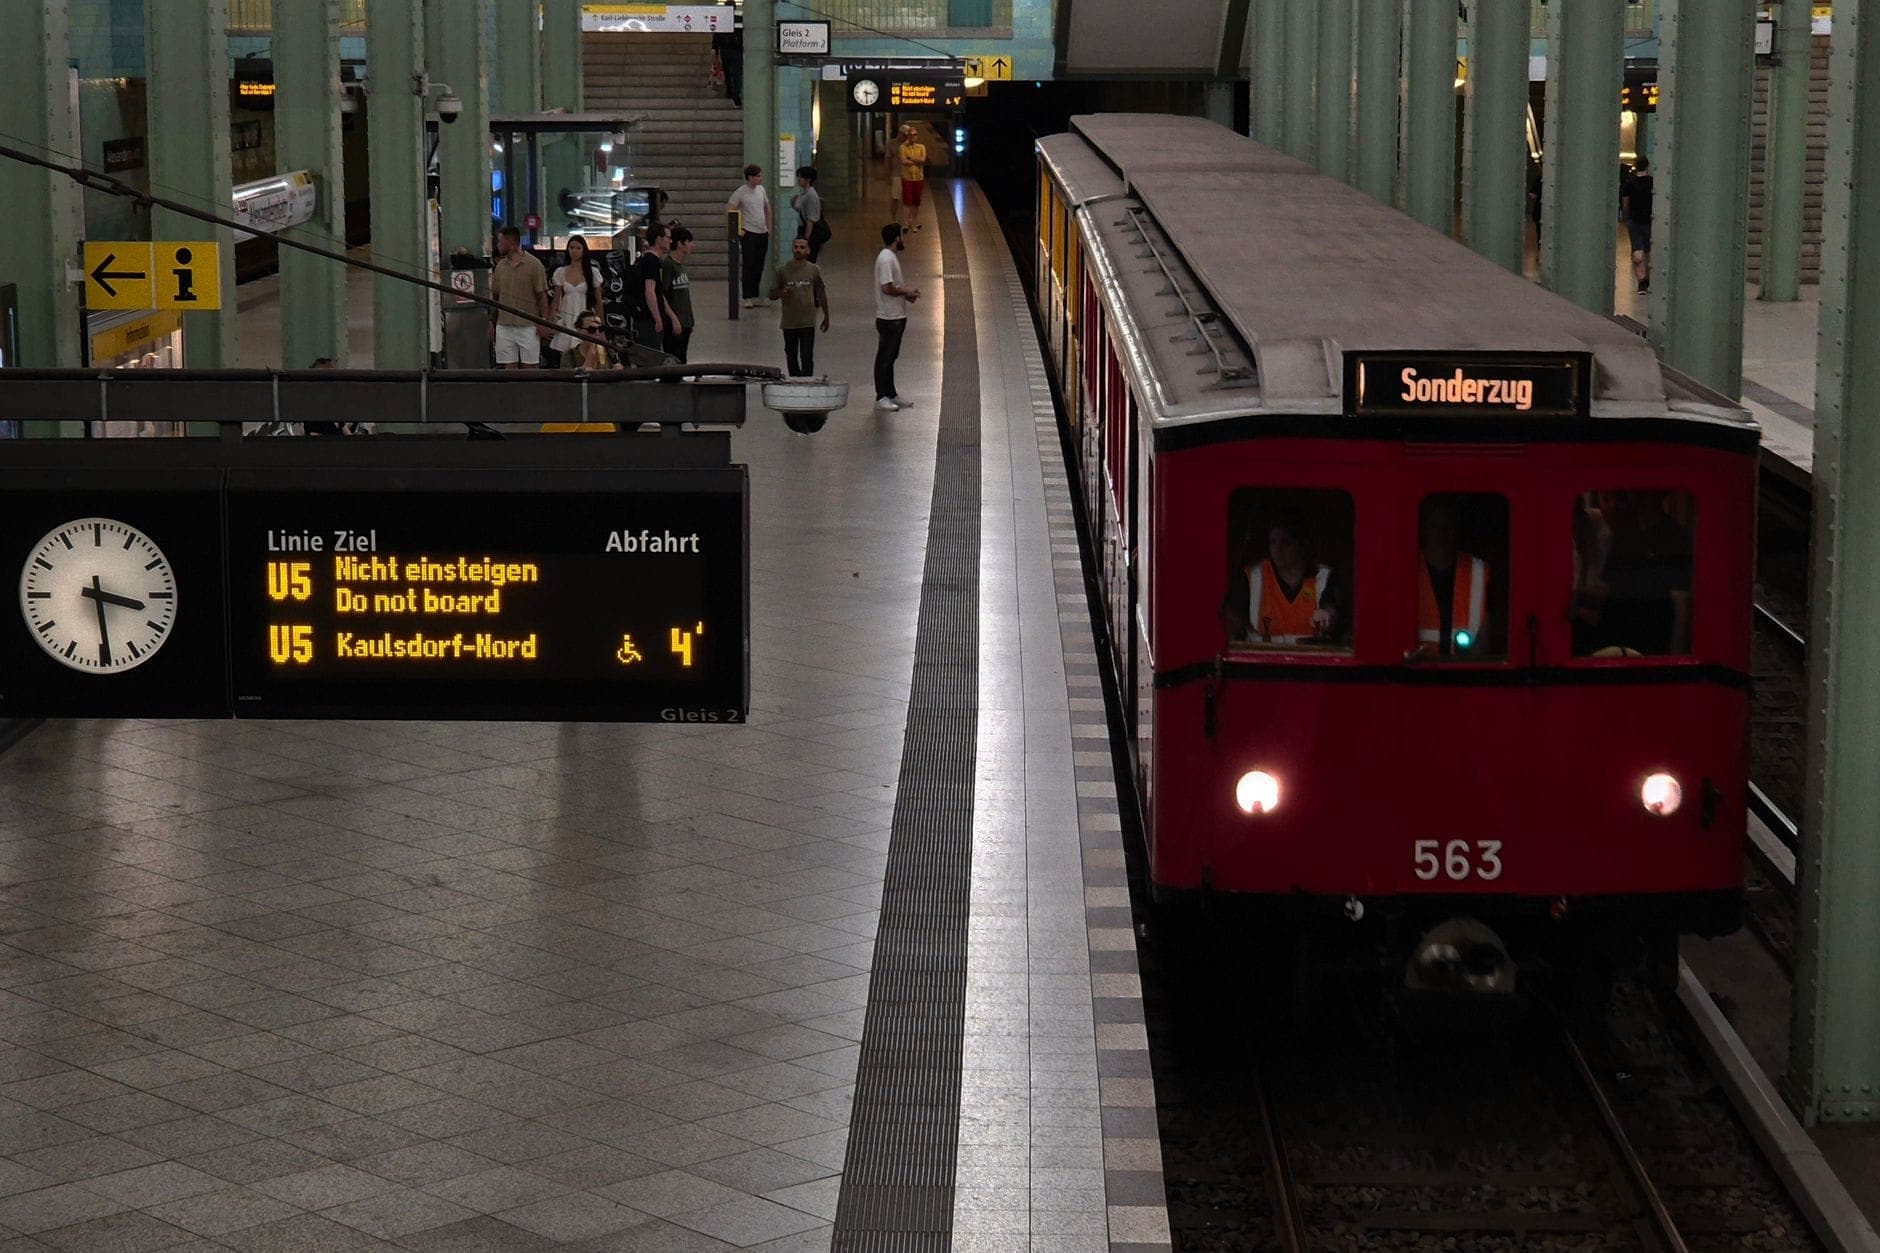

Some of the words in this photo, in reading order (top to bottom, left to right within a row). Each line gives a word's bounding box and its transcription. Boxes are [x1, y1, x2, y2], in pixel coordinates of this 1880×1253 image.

[782, 28, 803, 38] Gleis
[804, 28, 810, 38] 2
[782, 39, 819, 49] Platform
[820, 39, 826, 49] 2
[1401, 367, 1533, 410] Sonderzug
[267, 530, 323, 552] Linie
[334, 530, 377, 552] Ziel
[605, 530, 700, 553] Abfahrt
[267, 562, 311, 600] U5
[335, 556, 399, 582] Nicht
[405, 557, 538, 586] einsteigen
[336, 587, 368, 613] Do
[374, 588, 418, 613] not
[423, 588, 500, 613] board
[269, 625, 313, 663] U5
[337, 633, 537, 659] Kaulsdorf-Nord
[660, 708, 719, 722] Gleis
[727, 709, 740, 722] 2
[1414, 839, 1502, 881] 563
